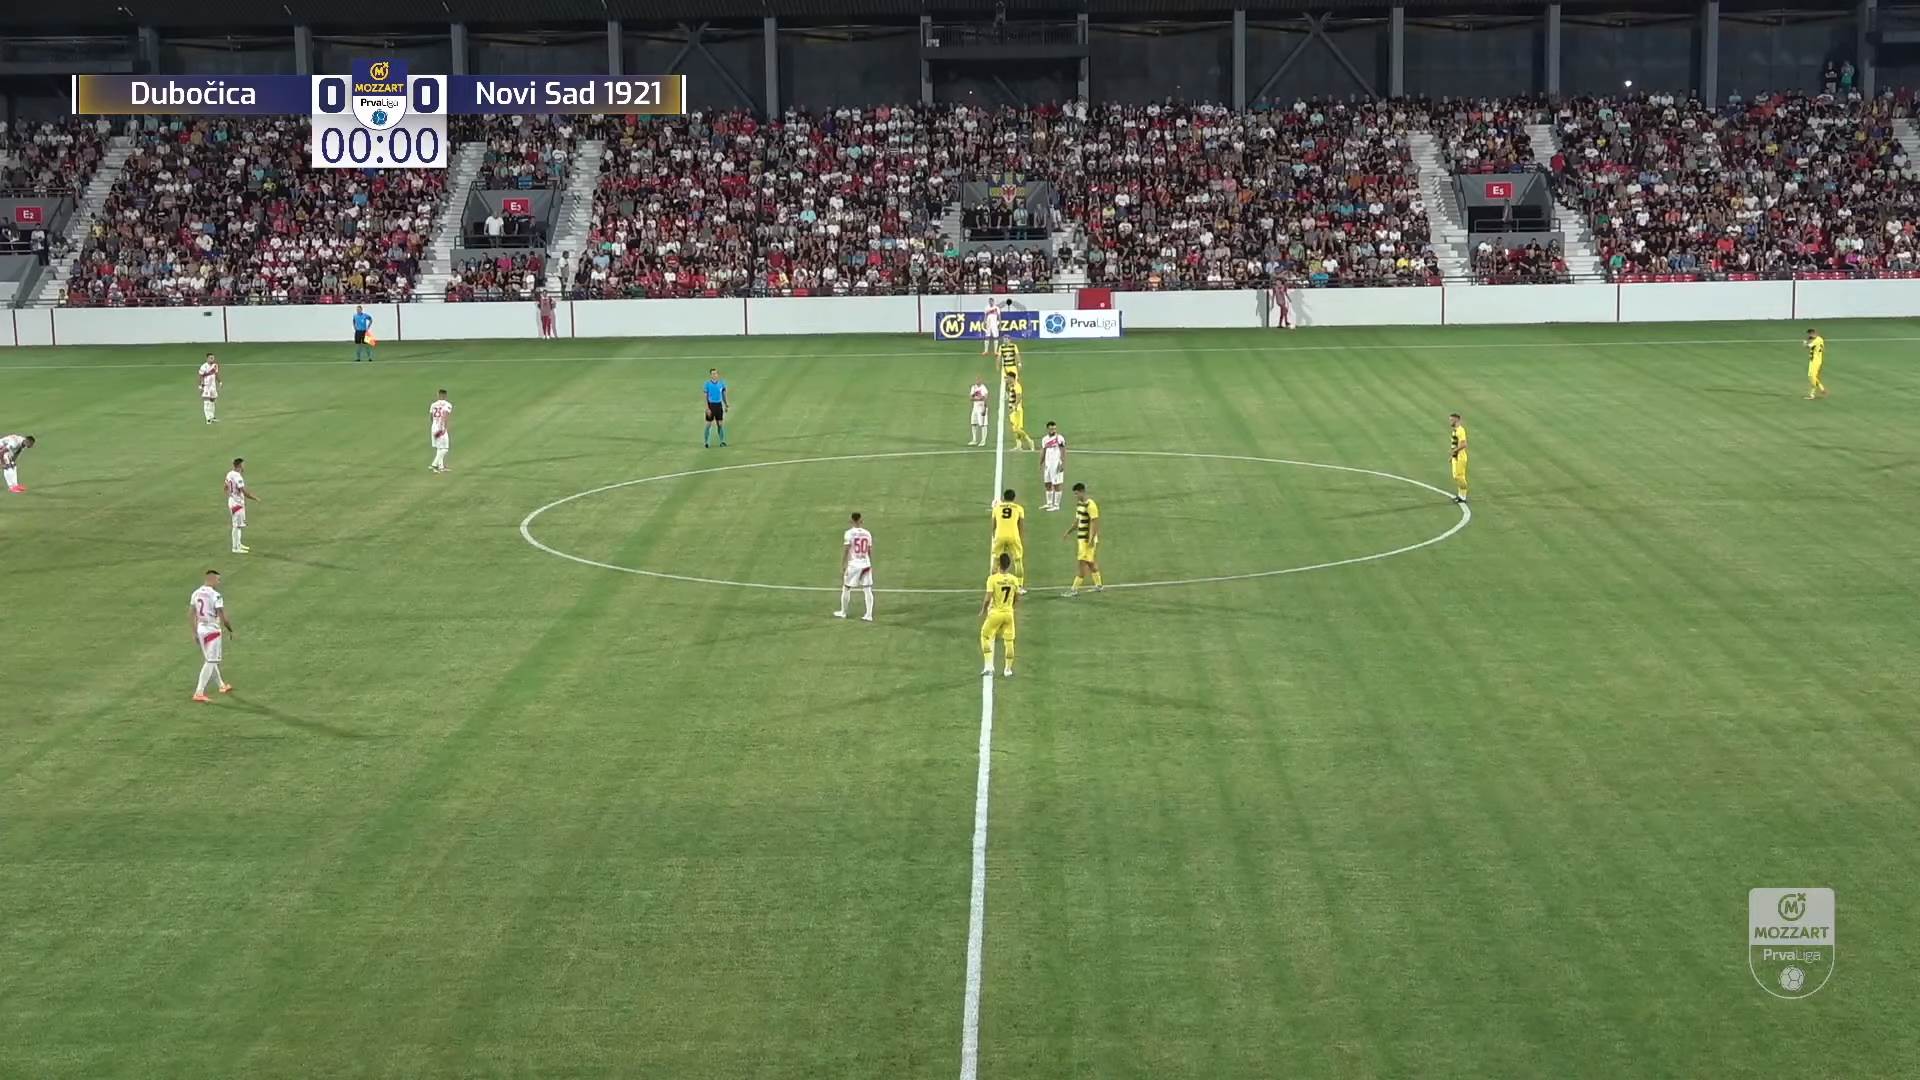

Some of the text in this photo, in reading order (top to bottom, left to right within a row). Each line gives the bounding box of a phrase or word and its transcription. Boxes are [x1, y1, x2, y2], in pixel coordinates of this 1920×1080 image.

[1070, 317, 1117, 331] PrvaLiga
[1002, 507, 1012, 519] 9
[854, 538, 868, 553] 50
[1001, 586, 1011, 603] 7
[197, 598, 205, 616] 2
